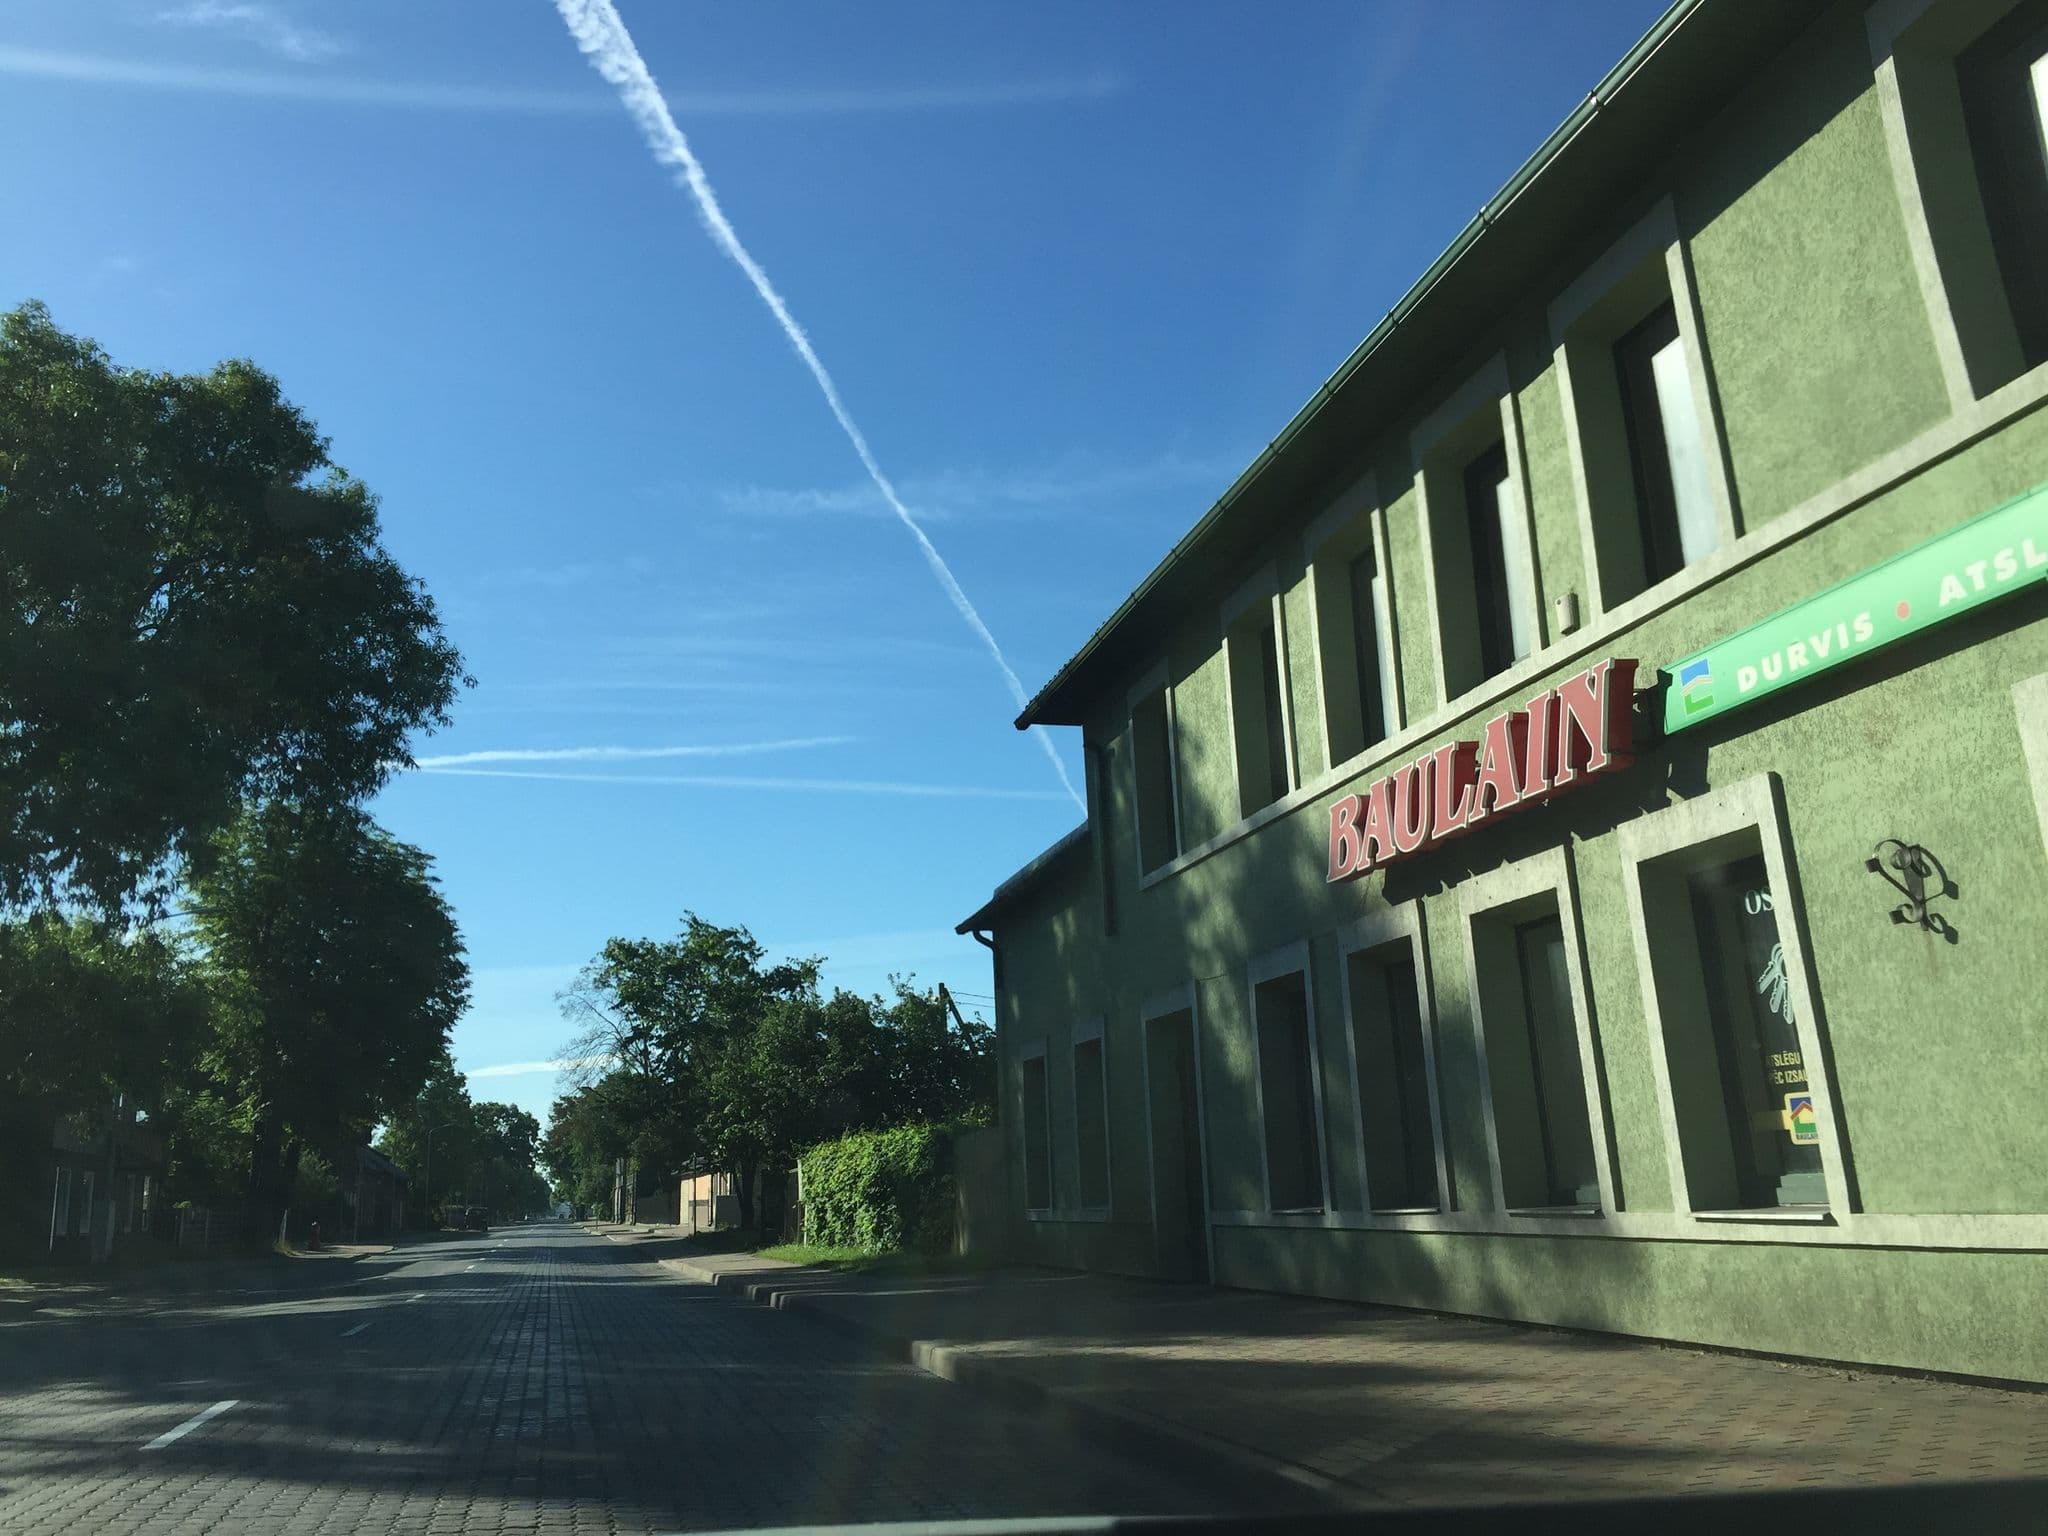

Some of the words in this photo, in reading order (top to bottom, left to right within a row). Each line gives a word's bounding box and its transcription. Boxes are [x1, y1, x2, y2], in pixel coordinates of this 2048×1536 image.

[1737, 611, 1874, 693] DURVIS
[1939, 538, 2048, 608] ATSL
[1326, 657, 1617, 883] BAULAIN
